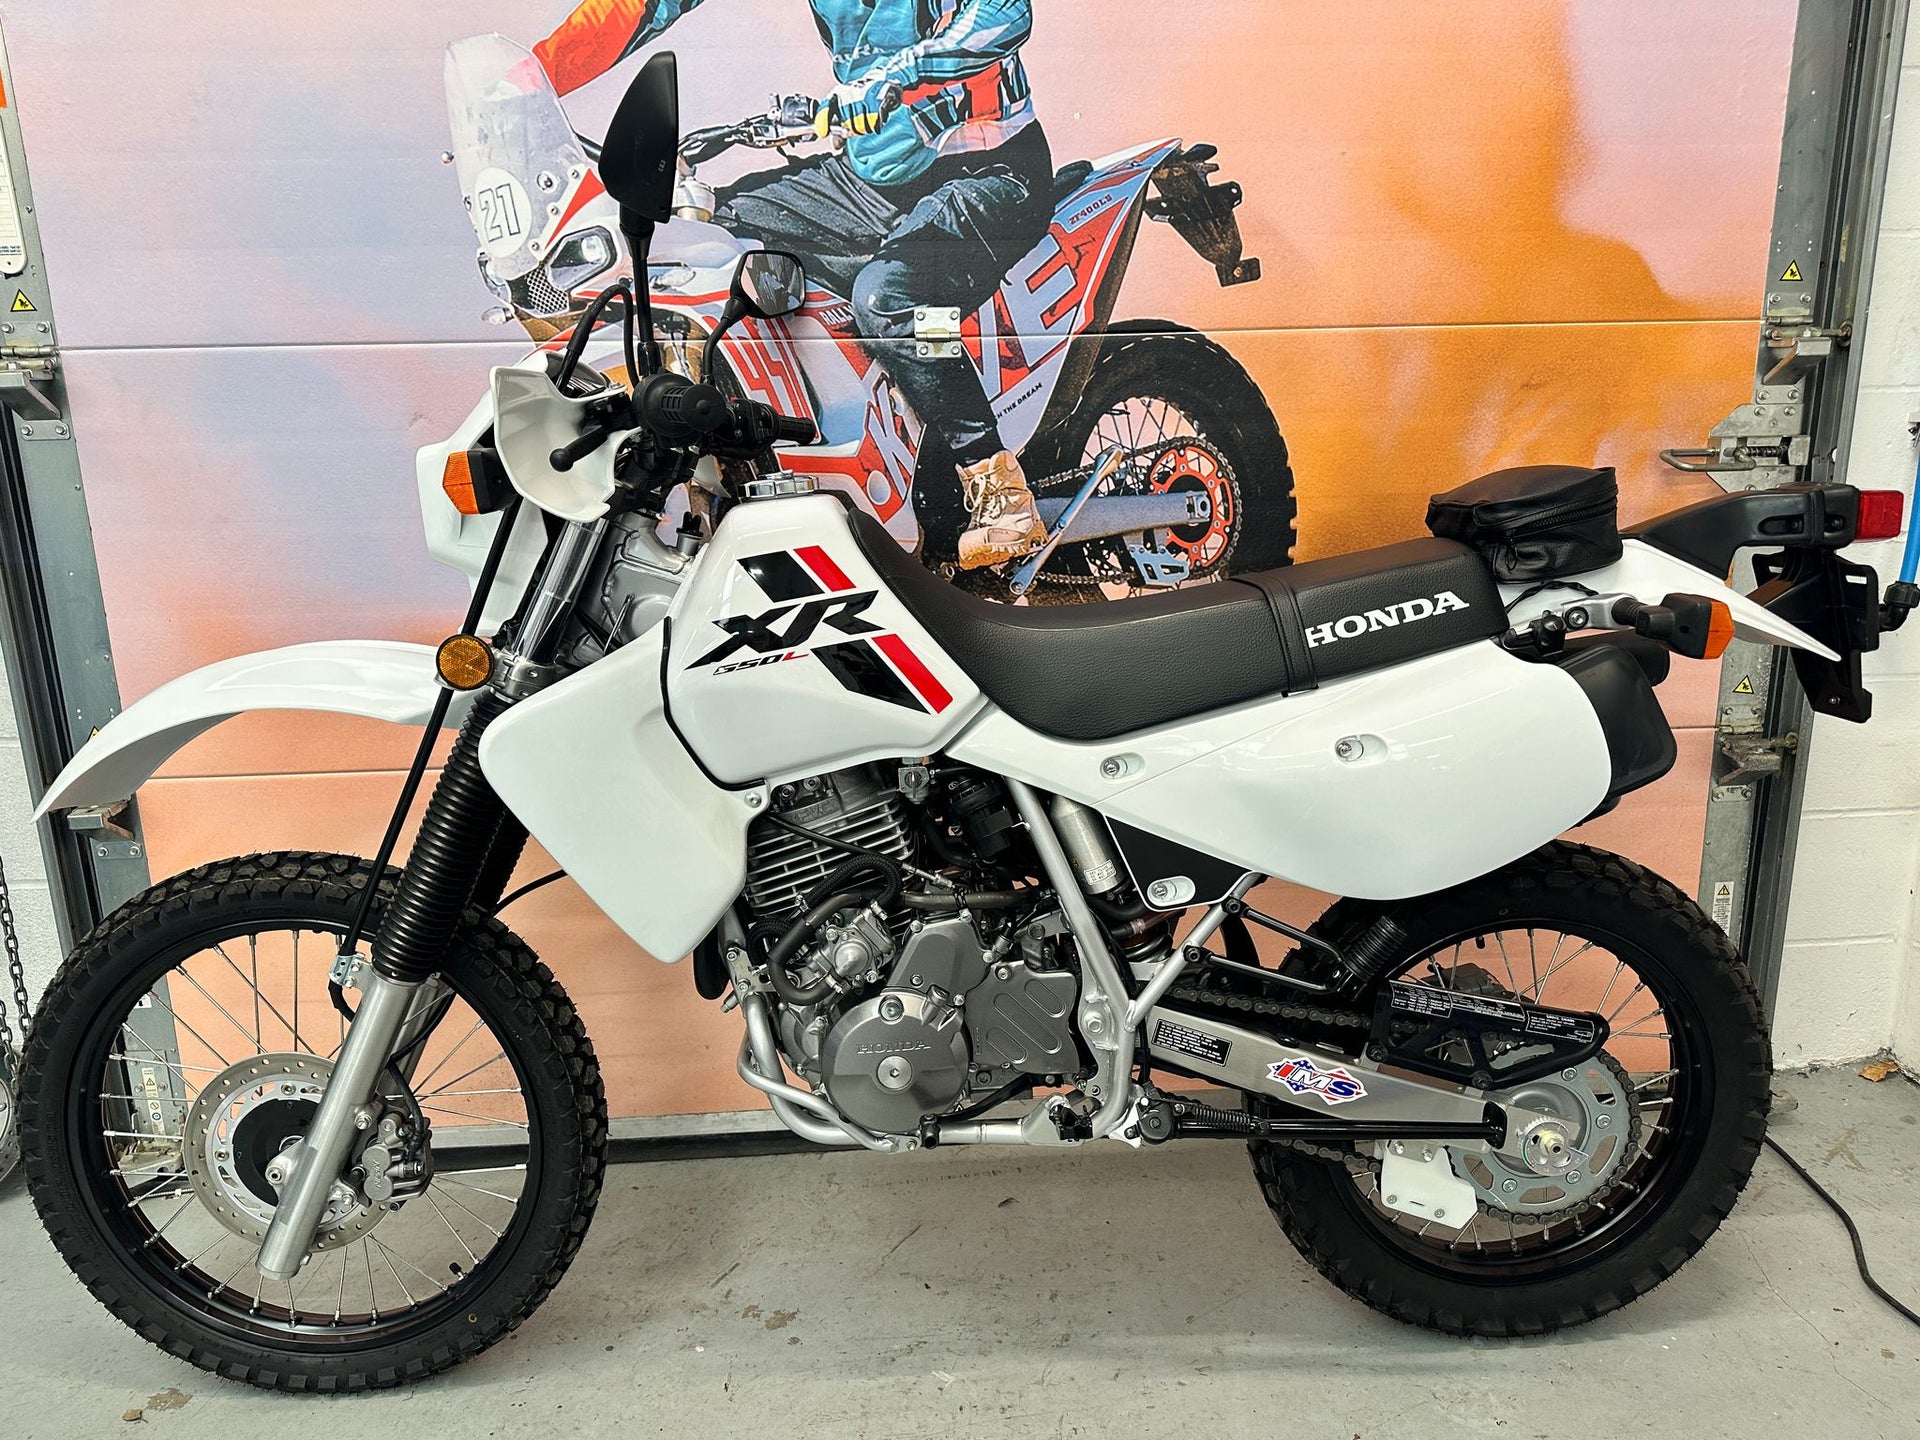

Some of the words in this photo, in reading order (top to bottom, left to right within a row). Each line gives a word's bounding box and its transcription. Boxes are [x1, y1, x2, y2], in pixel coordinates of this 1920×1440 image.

[478, 182, 521, 243] 21
[1003, 402, 1017, 414] THE
[1017, 383, 1042, 404] DREAM
[684, 590, 886, 671] XR
[1305, 591, 1470, 648] HONDA
[856, 1041, 932, 1054] HONDA
[1276, 1062, 1359, 1098] IMS
